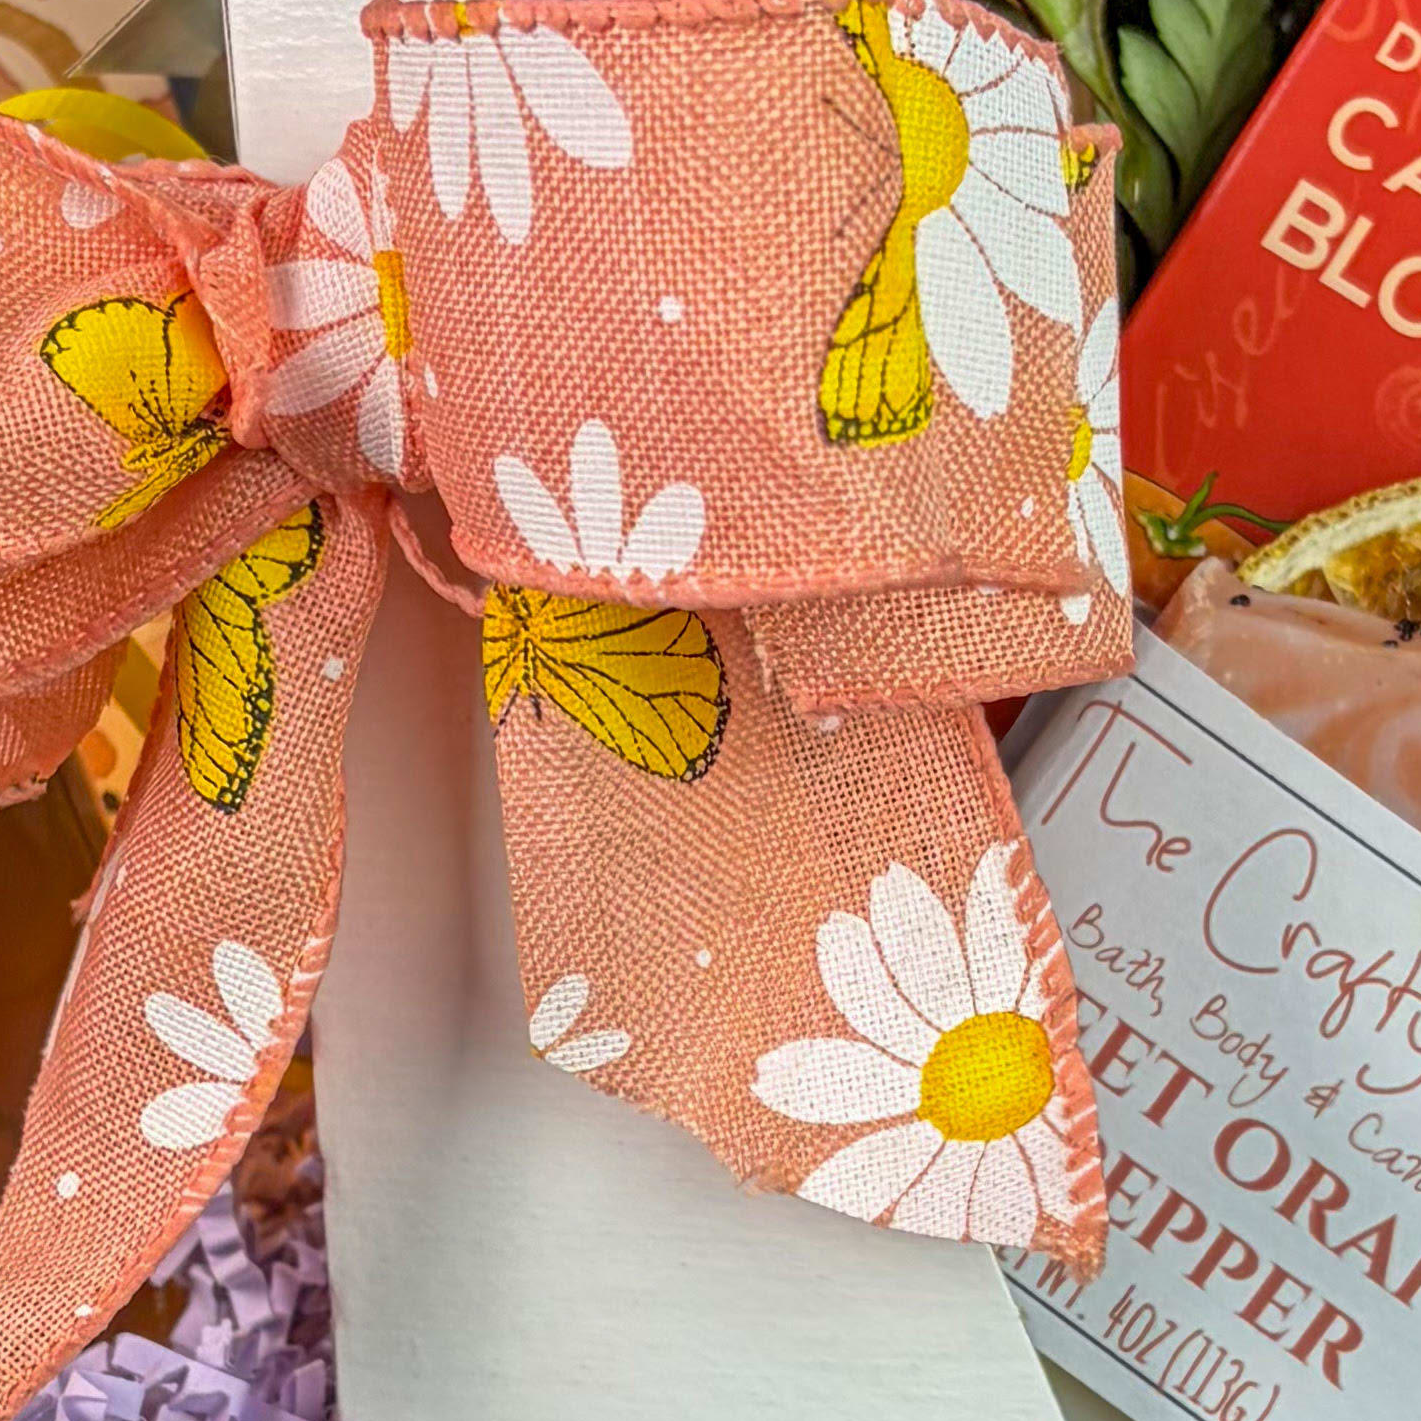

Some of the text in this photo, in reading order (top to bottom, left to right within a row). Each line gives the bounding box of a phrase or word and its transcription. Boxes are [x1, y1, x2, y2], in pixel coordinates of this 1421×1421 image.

[1042, 699, 1194, 874] The
[1065, 903, 1165, 1018] Bath,
[1189, 994, 1289, 1109] Body
[1303, 1079, 1344, 1119] &
[1098, 1133, 1367, 1392] EPPER
